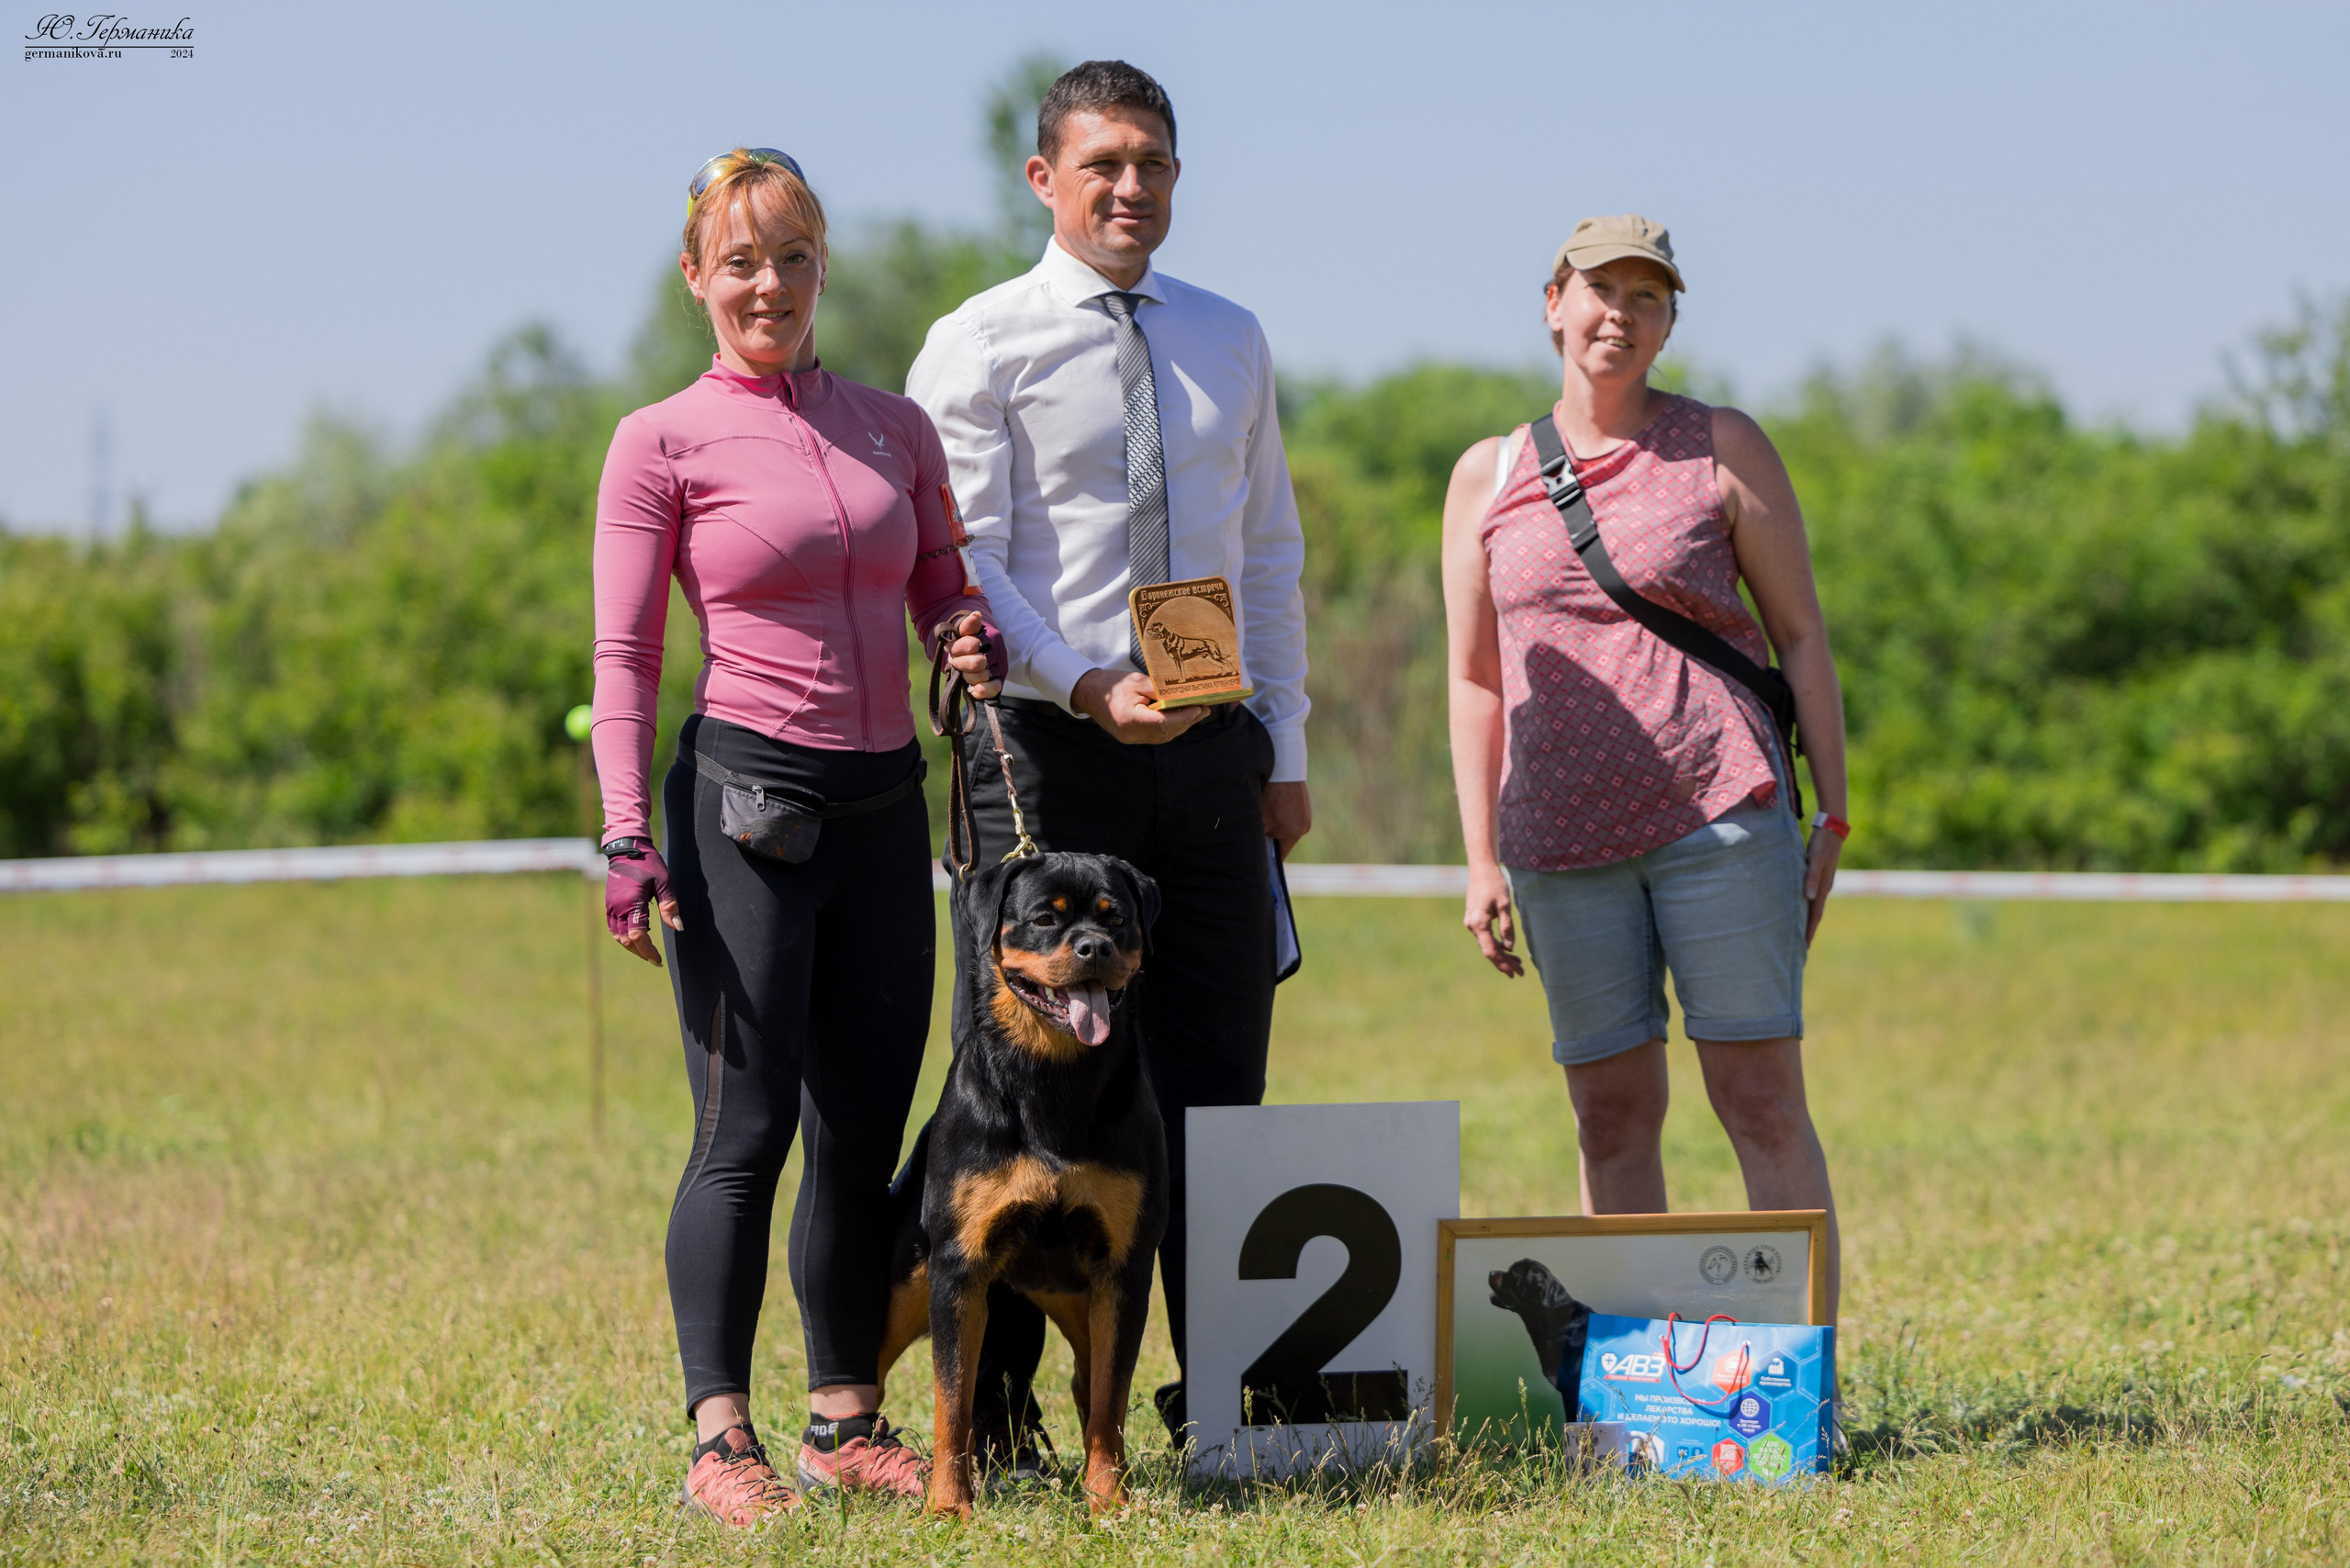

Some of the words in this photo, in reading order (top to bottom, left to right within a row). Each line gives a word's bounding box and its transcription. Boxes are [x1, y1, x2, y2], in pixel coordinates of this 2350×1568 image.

[1192, 582, 1224, 594] встречи
[1238, 1183, 1408, 1426] 2
[1645, 1405, 1694, 1415] ЛЕКАРСТВА
[1625, 1414, 1660, 1422] ДЕЛАЕМ
[1661, 1416, 1679, 1424] ЭТО
[1680, 1417, 1721, 1427] ХОРОШО!
